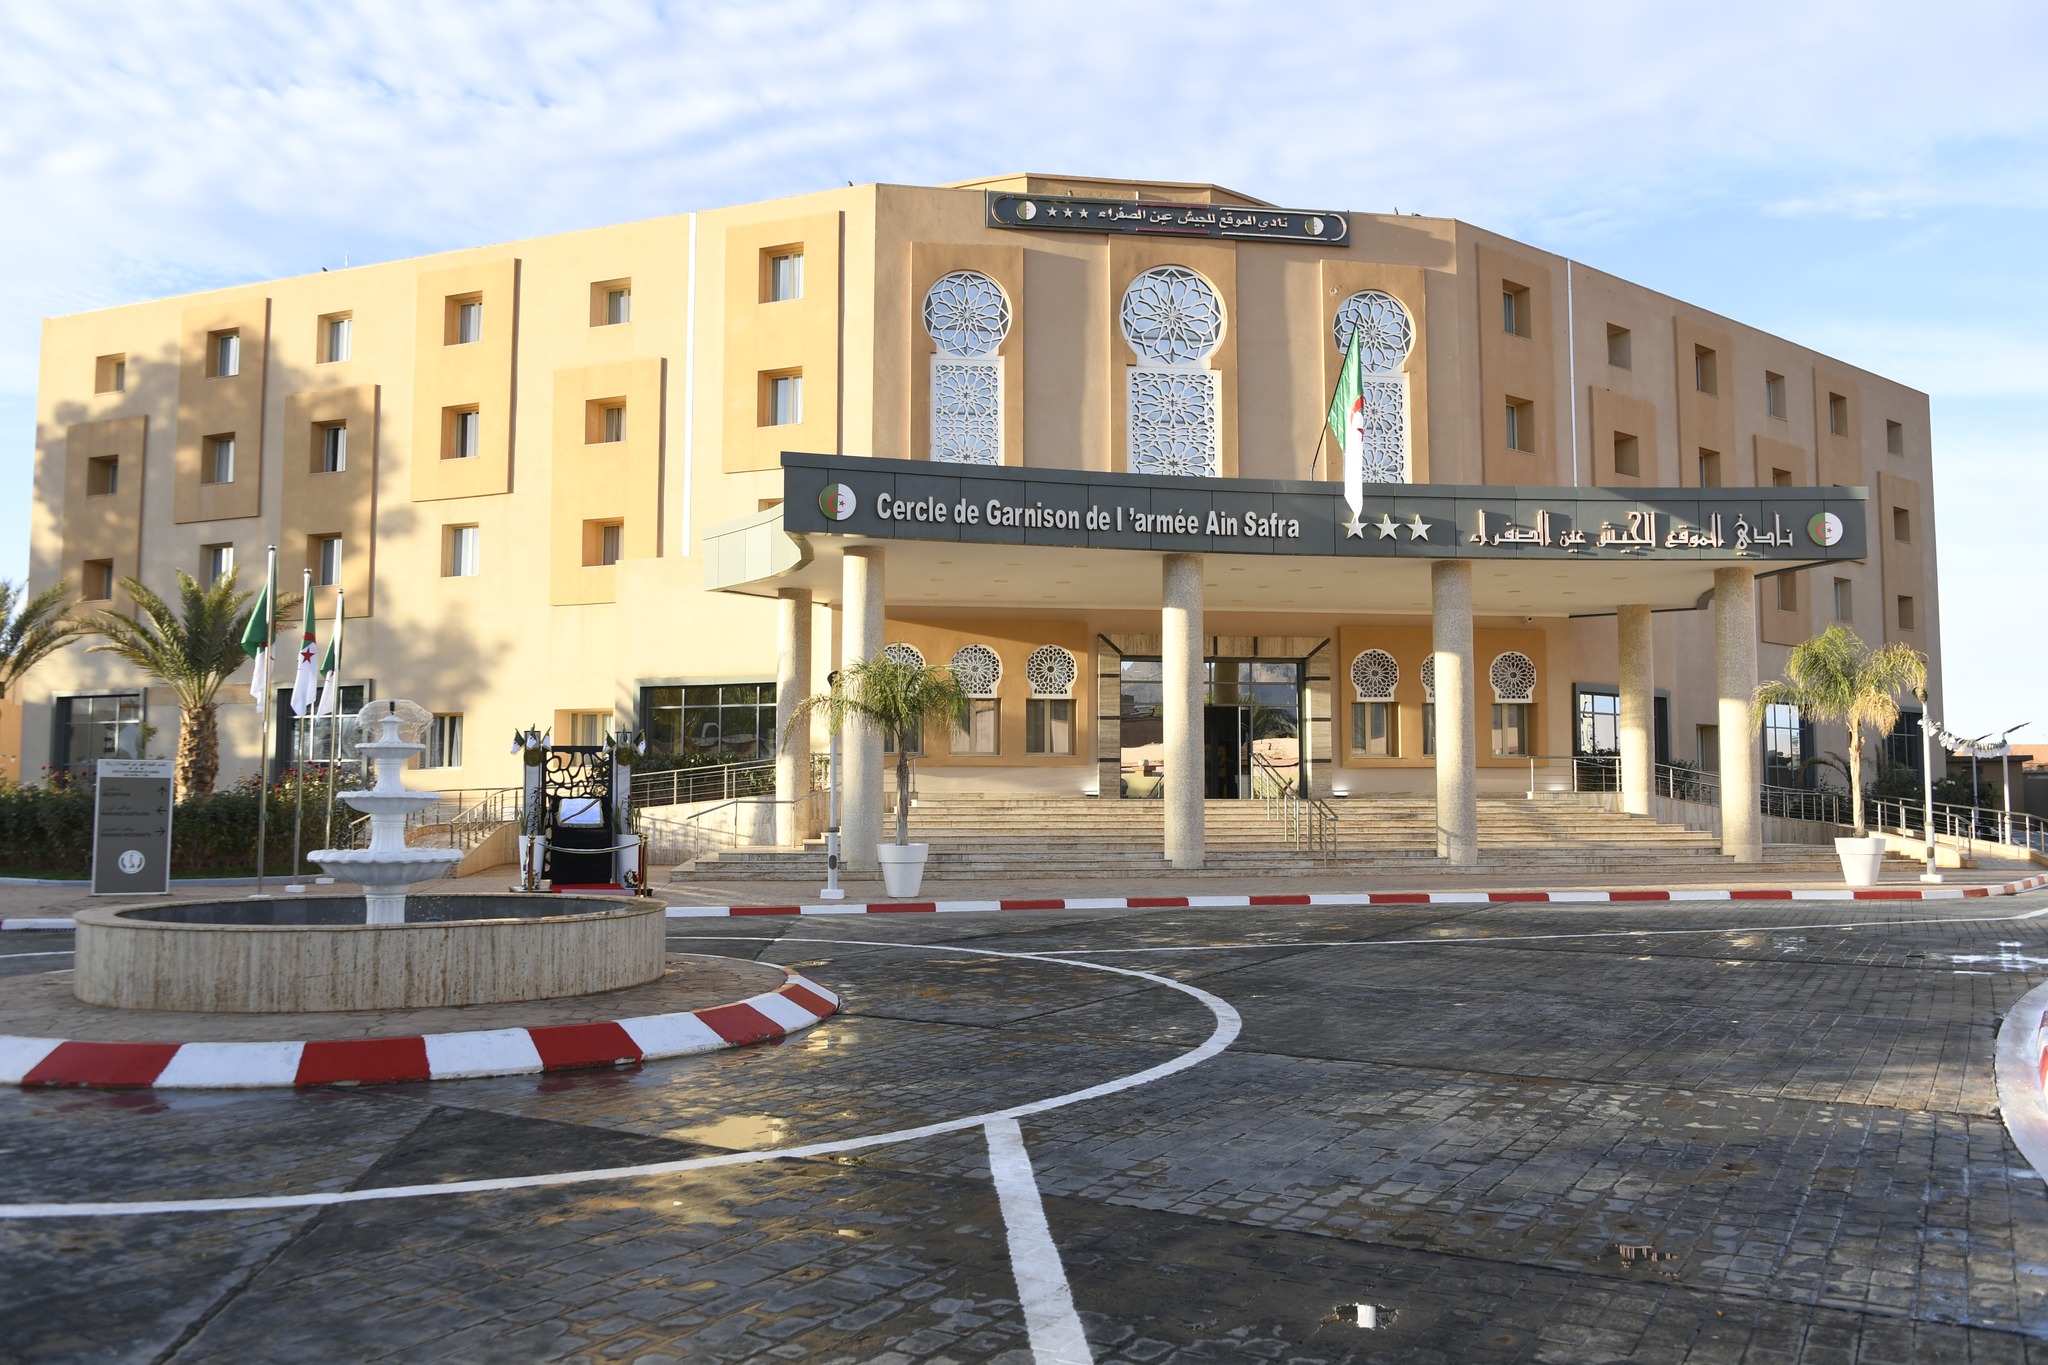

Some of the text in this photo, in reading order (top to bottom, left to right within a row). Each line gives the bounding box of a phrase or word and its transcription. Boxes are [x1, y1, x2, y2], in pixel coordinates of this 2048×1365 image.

[1098, 207, 1288, 231] نادي الموقع للجيش عين الصفراء
[877, 492, 947, 523] Cercle
[954, 498, 979, 524] de
[986, 499, 1080, 530] Garnison
[1086, 505, 1111, 531] de
[1205, 510, 1238, 536] Ain
[1244, 511, 1300, 538] Safra
[1470, 509, 1553, 547] الصفراء
[1595, 511, 1656, 554] للجيش
[1665, 511, 1726, 548] الموقع
[1733, 511, 1793, 556] نادي
